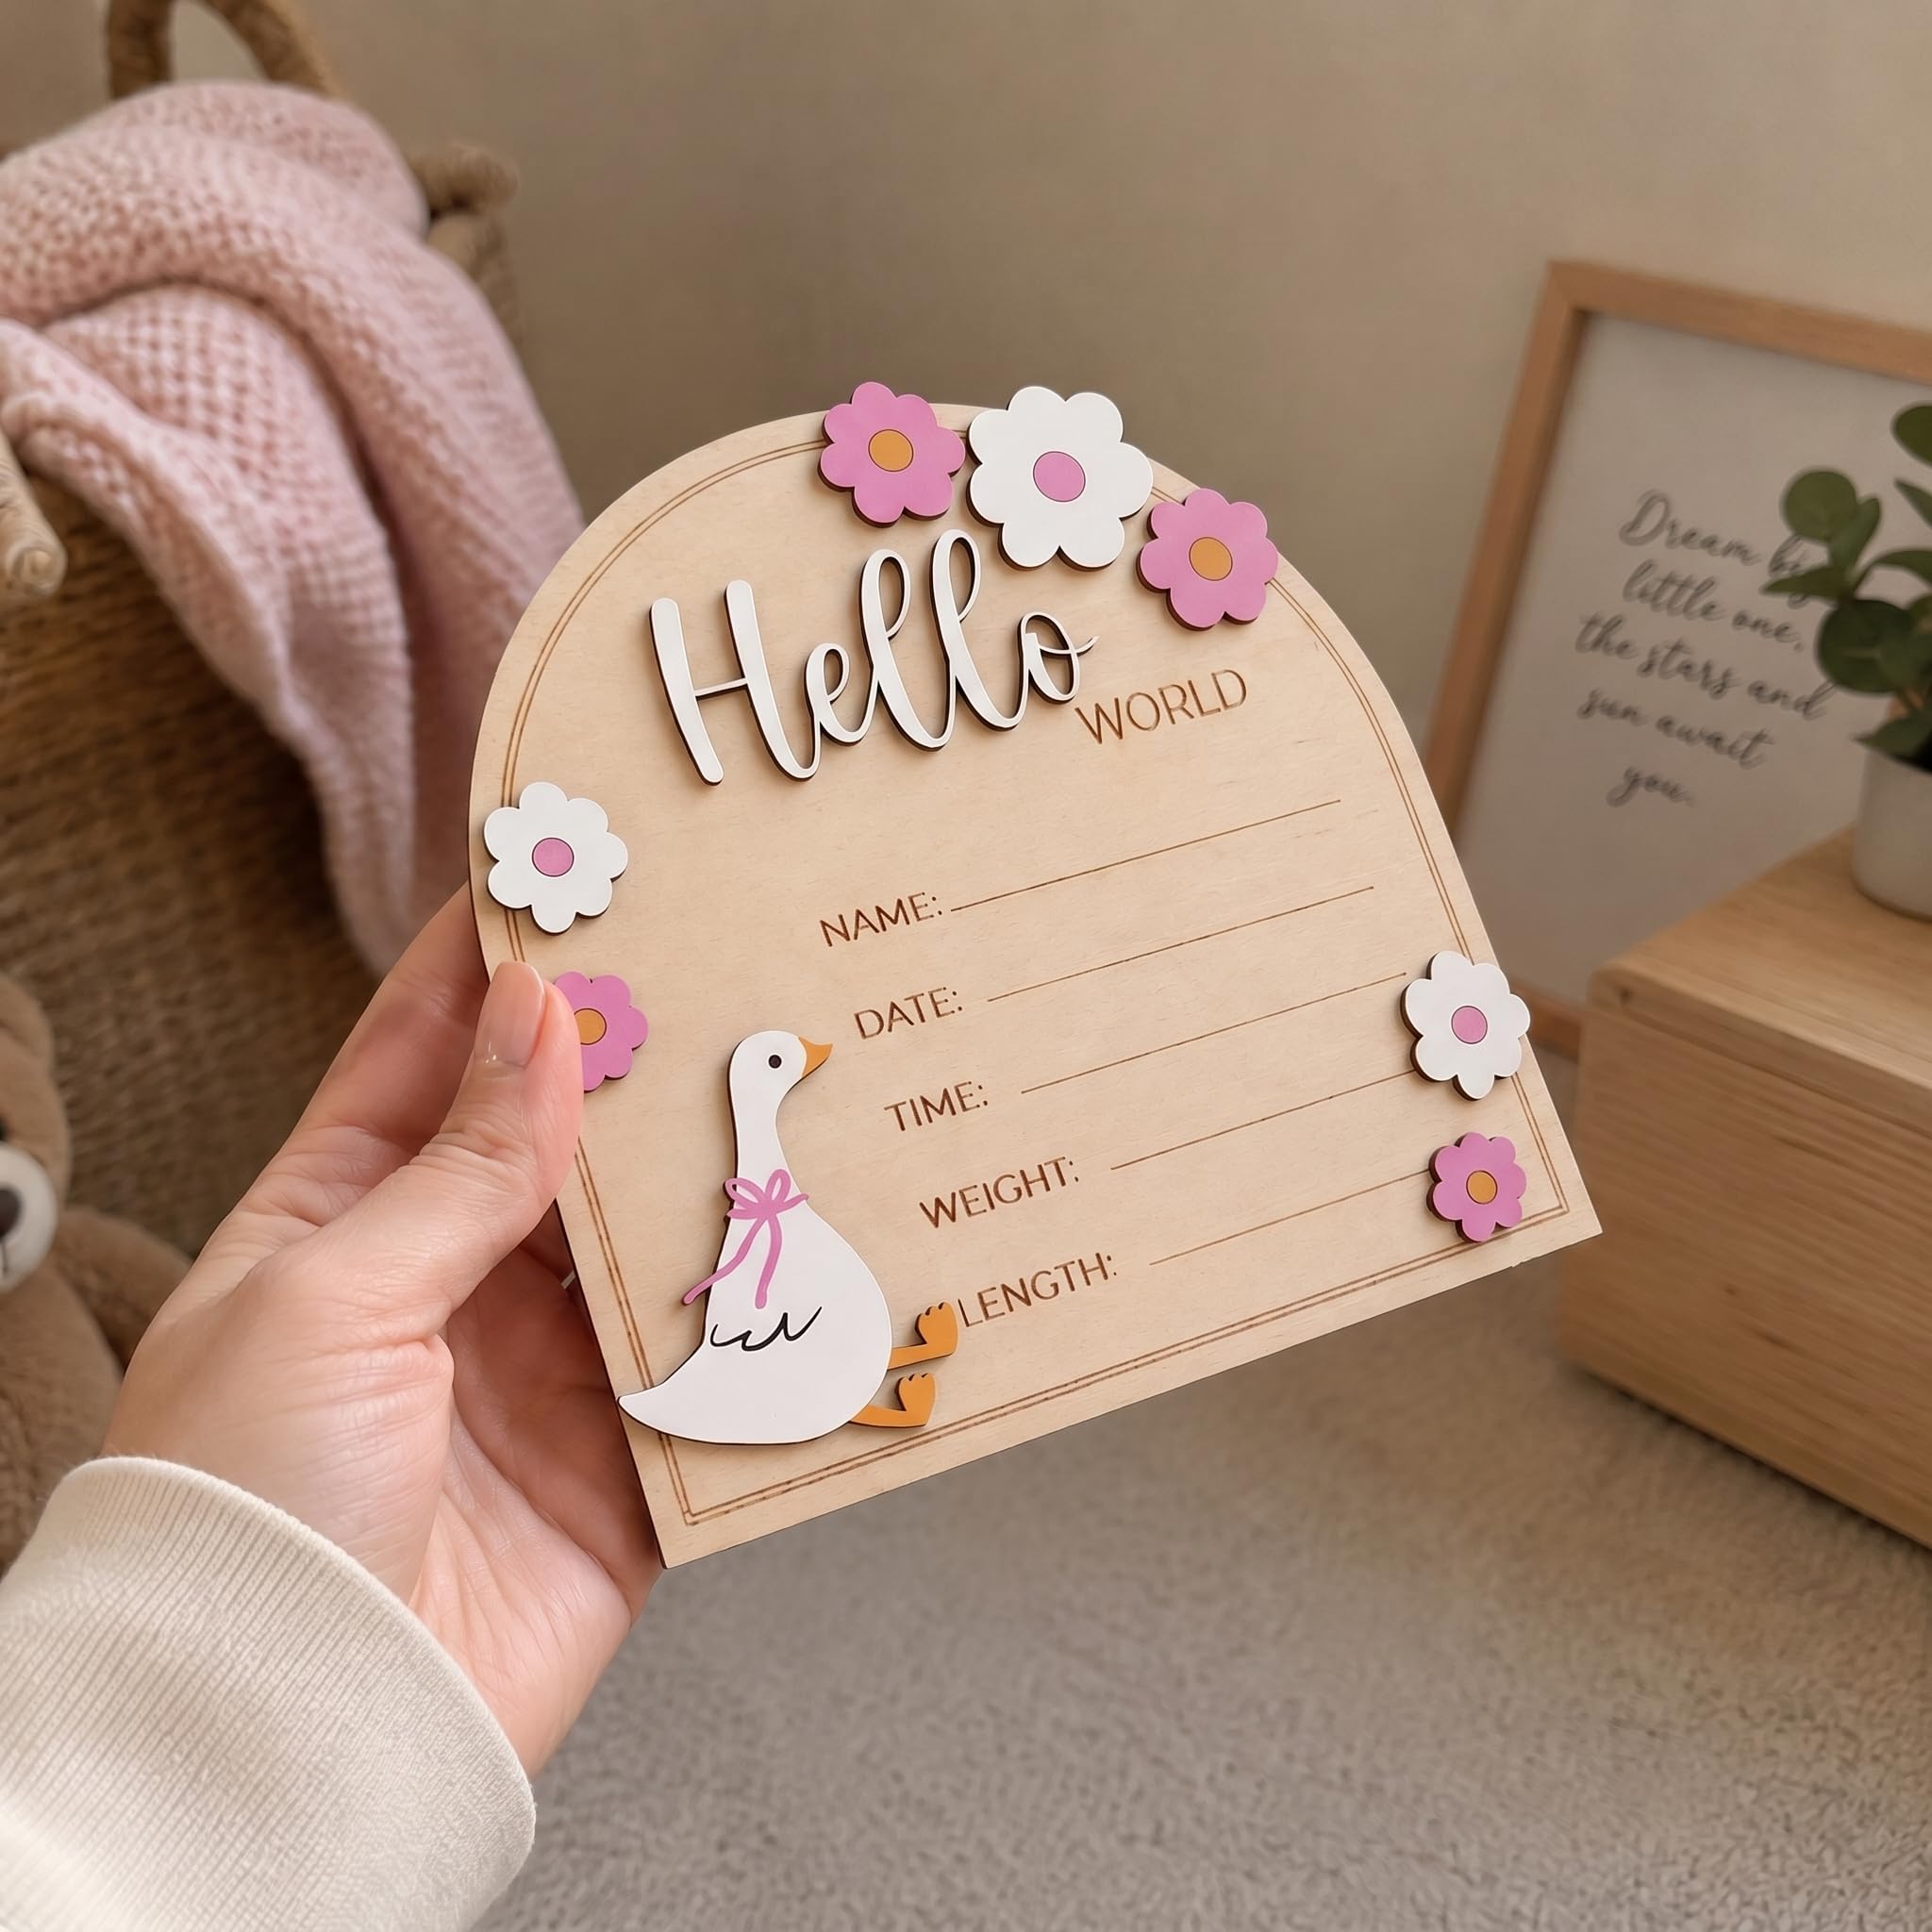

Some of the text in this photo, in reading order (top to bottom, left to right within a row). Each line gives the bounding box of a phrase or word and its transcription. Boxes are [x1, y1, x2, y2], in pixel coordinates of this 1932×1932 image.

[1619, 490, 1759, 565] Dream
[1623, 559, 1726, 621] little
[649, 529, 1099, 785] Hello
[1574, 612, 1838, 720] the stars and
[1075, 668, 1247, 744] WORLD
[819, 891, 943, 947] NAME:
[854, 987, 963, 1040] DATE:
[884, 1081, 989, 1131] TIME:
[919, 1156, 1079, 1228] WEIGHT:
[957, 1252, 1118, 1328] LENGTH:
